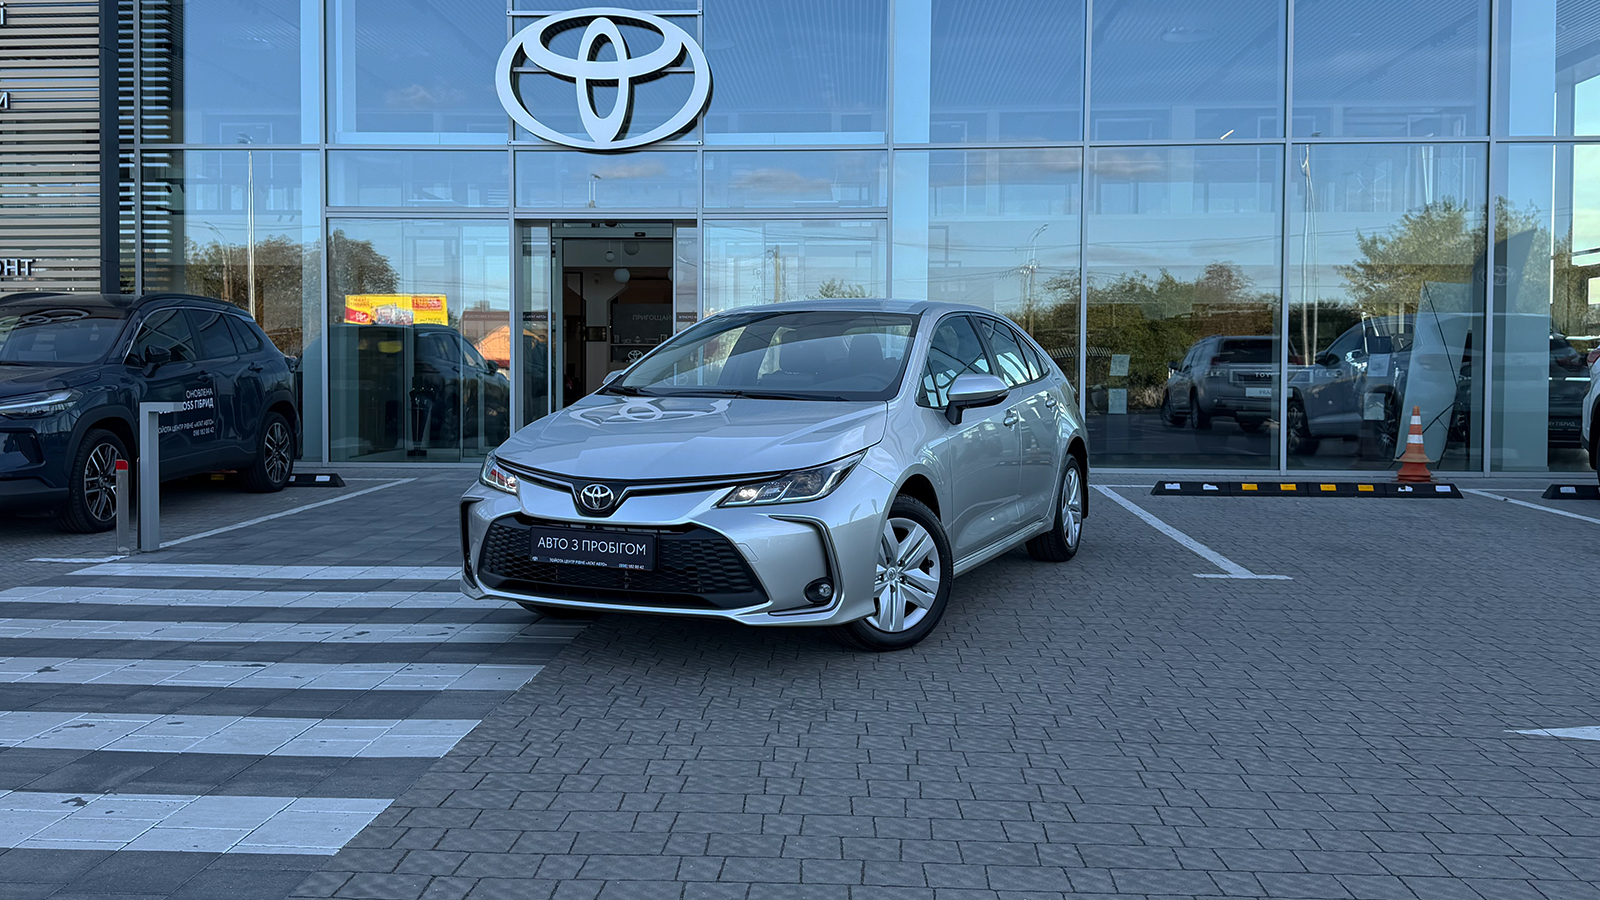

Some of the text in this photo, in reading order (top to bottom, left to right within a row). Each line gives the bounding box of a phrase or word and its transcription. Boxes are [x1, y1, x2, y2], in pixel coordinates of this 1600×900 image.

[186, 388, 213, 398] ОНОВЛЕНА
[182, 398, 214, 411] OSS ГІБРИД
[537, 536, 646, 556] АВТО З ПРОБІГОМ
